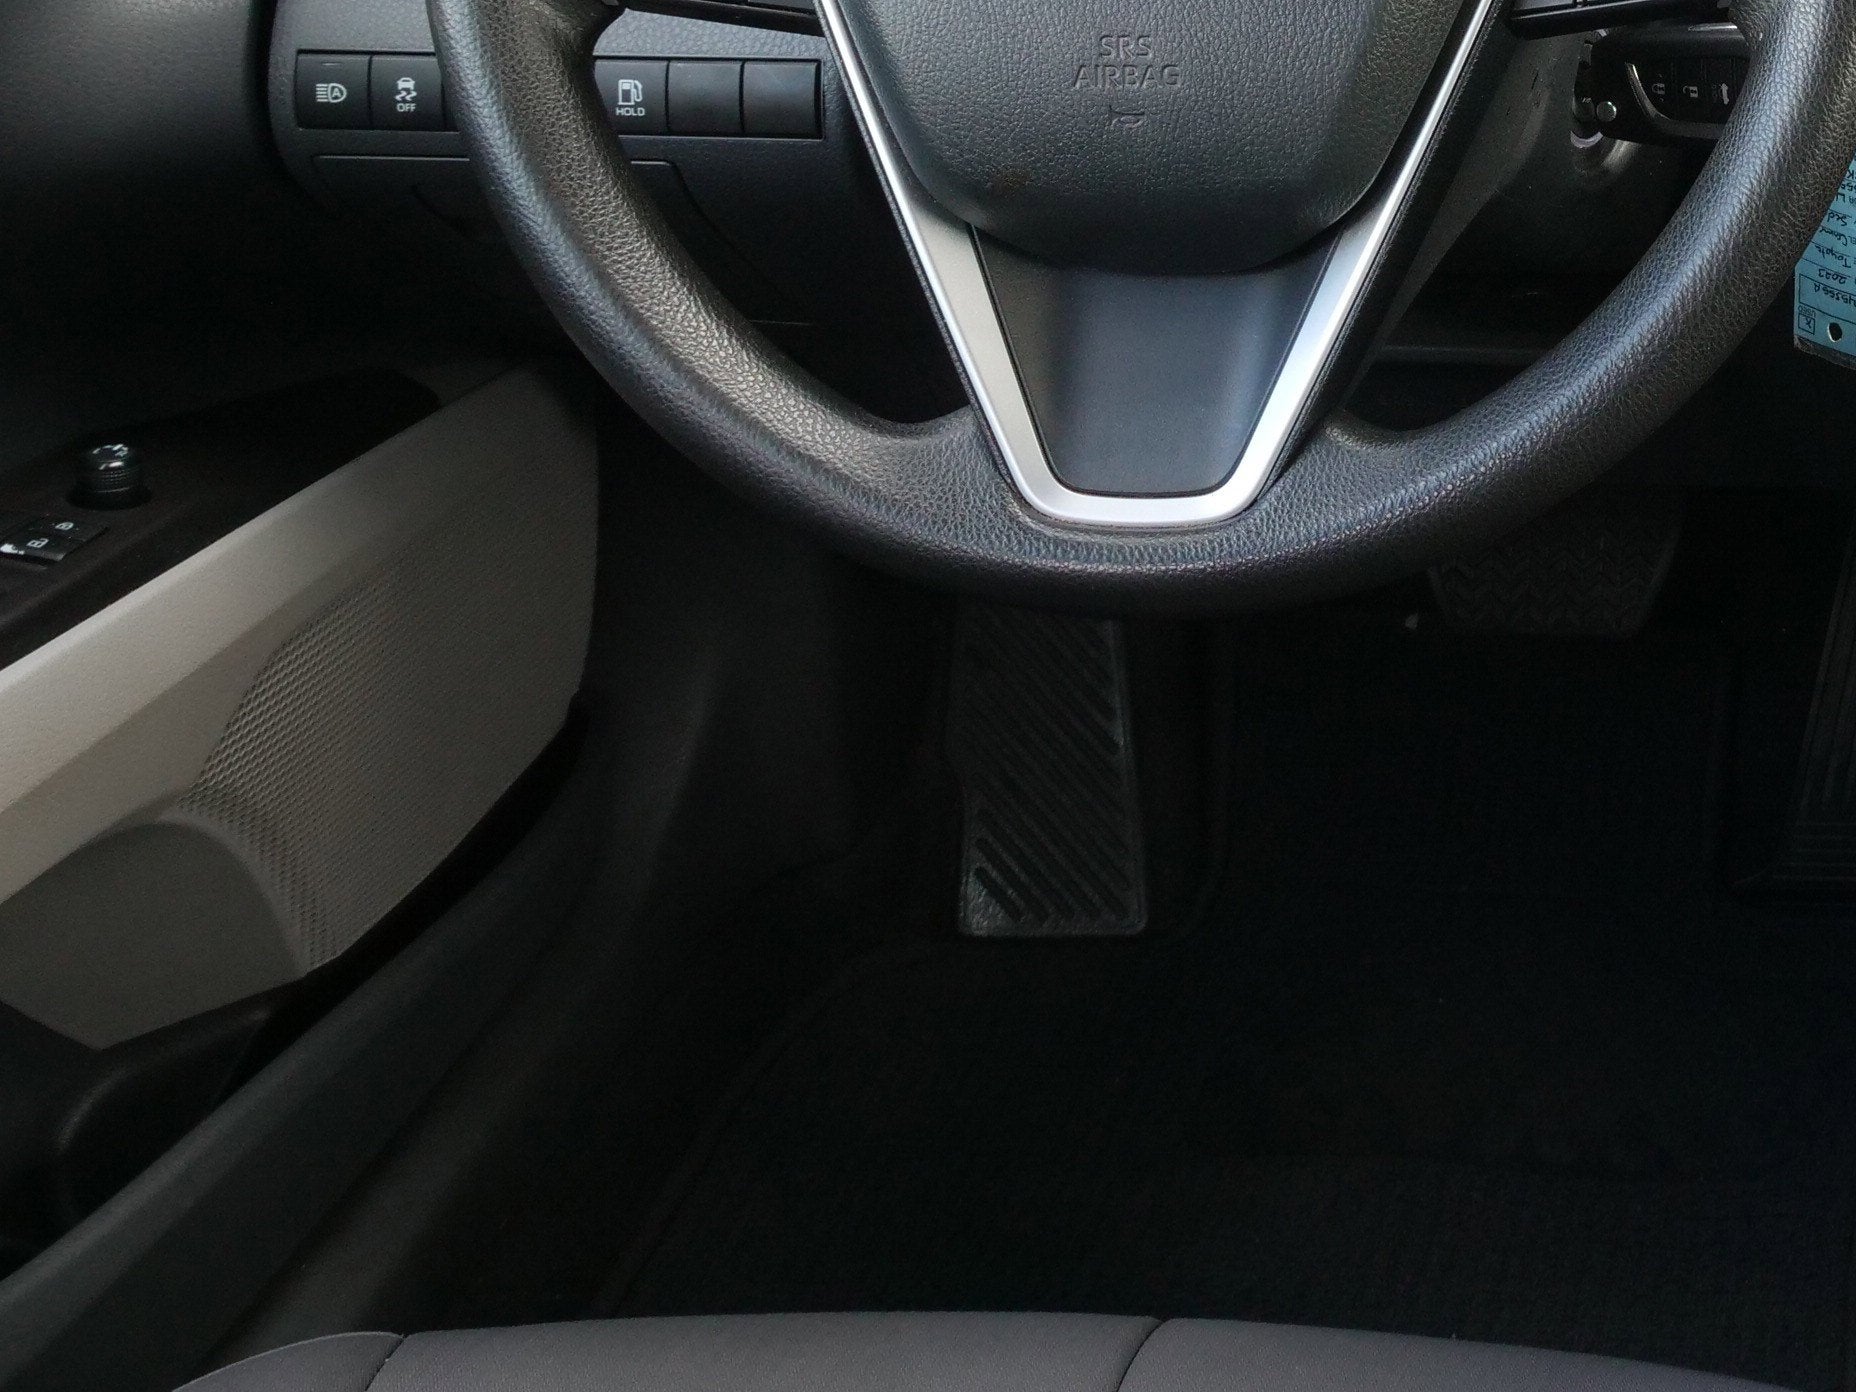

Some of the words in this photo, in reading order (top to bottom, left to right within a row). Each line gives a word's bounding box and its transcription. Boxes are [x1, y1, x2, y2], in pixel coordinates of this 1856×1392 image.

[1099, 35, 1152, 58] SRS
[1073, 64, 1183, 89] AIRBAG
[397, 103, 416, 112] OFF
[616, 107, 645, 116] HOLD
[1818, 269, 1847, 284] 2023
